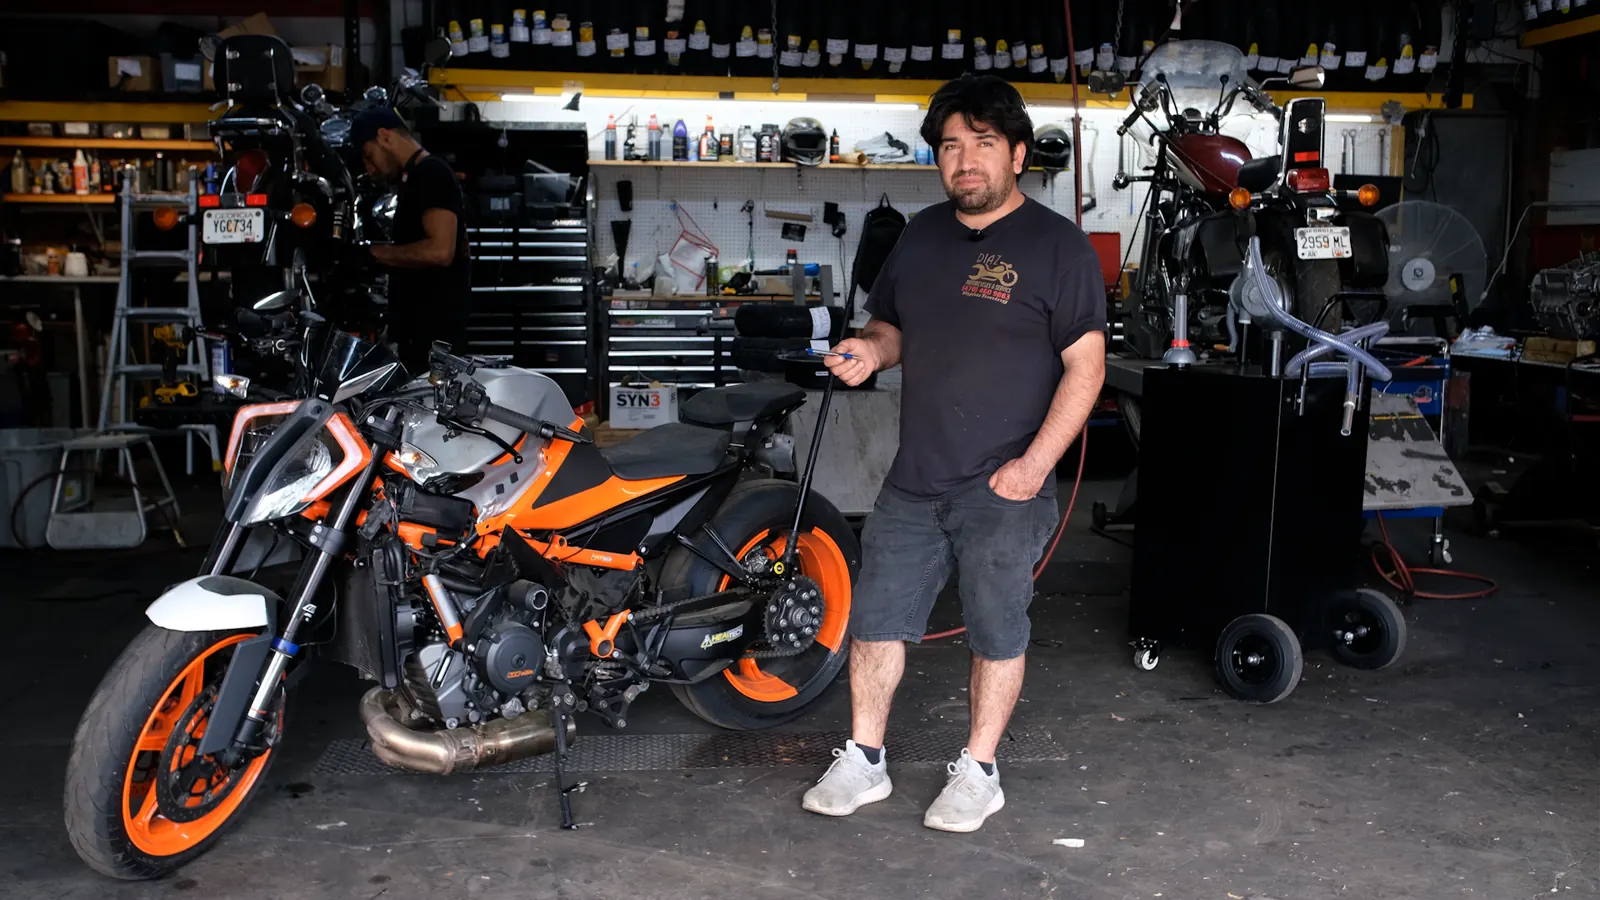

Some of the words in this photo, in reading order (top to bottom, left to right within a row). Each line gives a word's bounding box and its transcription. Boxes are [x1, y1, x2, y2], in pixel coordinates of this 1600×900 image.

[213, 219, 253, 232] YGC734
[1300, 236, 1330, 249] 2959
[1333, 236, 1347, 248] ML
[976, 252, 1002, 266] DIAZ
[616, 393, 661, 408] SYN3
